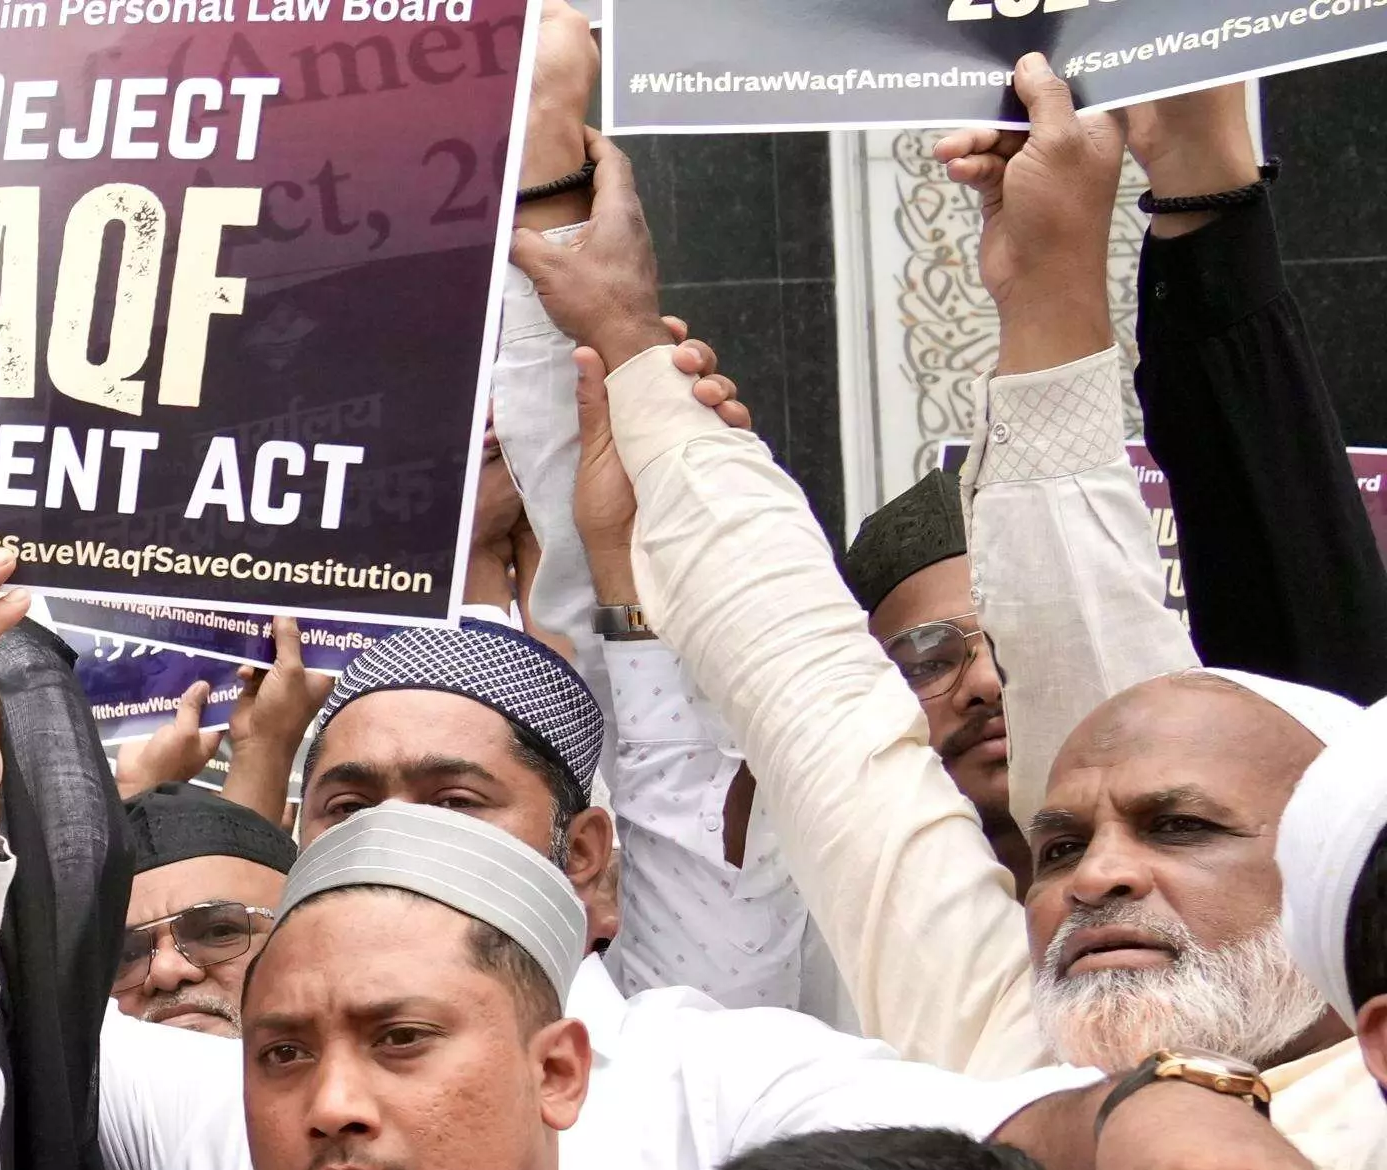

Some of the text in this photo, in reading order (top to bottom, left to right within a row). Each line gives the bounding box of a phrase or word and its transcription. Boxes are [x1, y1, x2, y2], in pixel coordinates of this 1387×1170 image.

[59, 0, 235, 26] Personal
[246, 0, 327, 22] Law
[342, 0, 475, 22] Board
[184, 436, 364, 529] ACT
